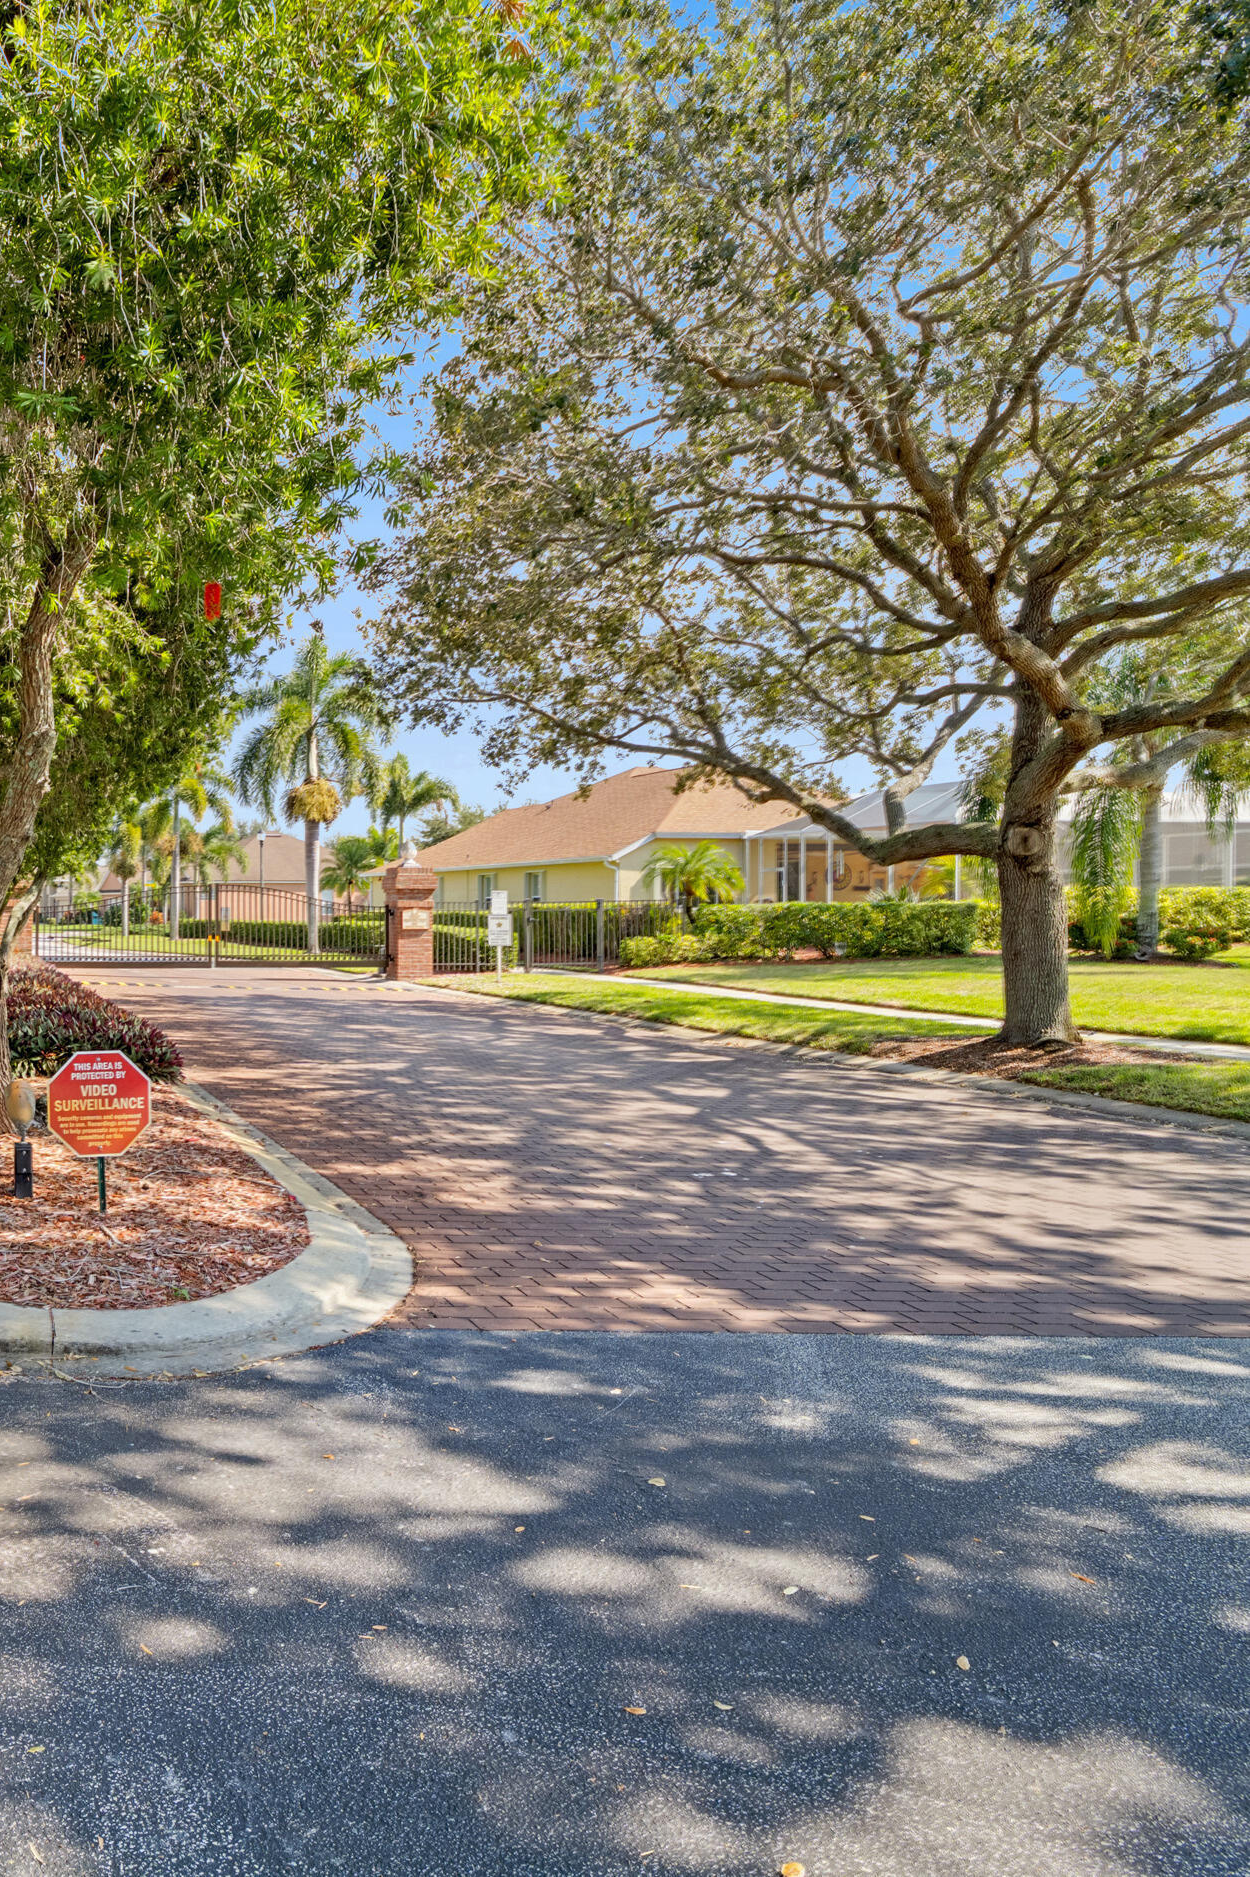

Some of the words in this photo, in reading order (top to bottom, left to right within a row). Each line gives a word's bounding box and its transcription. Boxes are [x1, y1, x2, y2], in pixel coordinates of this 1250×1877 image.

[74, 1063, 91, 1071] THIS
[93, 1062, 113, 1070] AREA
[71, 1072, 114, 1080] PROTECTED
[80, 1084, 117, 1096] VIDEO
[54, 1097, 145, 1112] SURVEILLANCE
